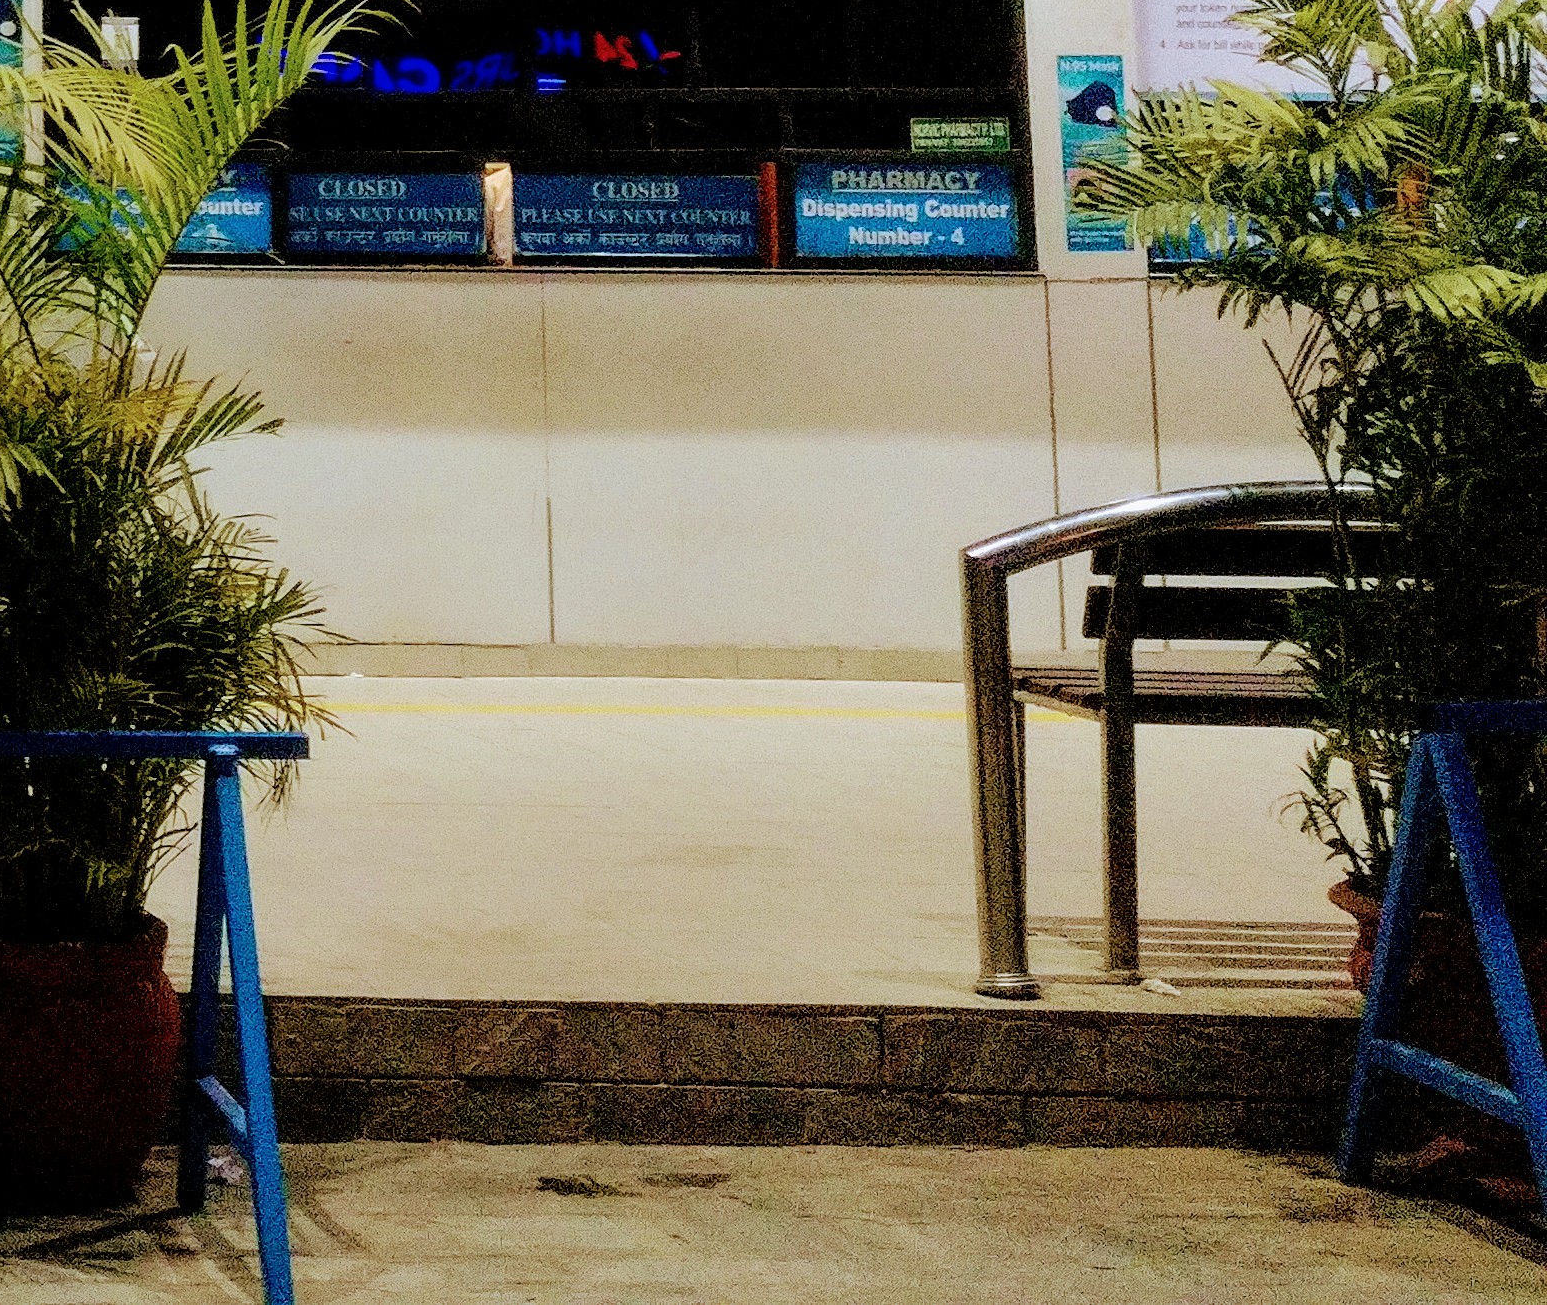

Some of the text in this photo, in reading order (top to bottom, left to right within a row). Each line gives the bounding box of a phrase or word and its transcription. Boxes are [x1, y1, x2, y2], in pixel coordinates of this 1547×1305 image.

[1176, 5, 1197, 15] your
[1178, 40, 1196, 49] Ask
[318, 180, 407, 197] CLOSED
[831, 170, 980, 190] PHARMACY
[593, 181, 679, 199] CLOSED
[198, 198, 264, 215] ounter
[350, 207, 393, 222] NEXT
[398, 207, 479, 222] COUNTER
[802, 198, 1010, 222] Dispensing Counter
[521, 208, 752, 224] PLEASE USE NEXT COUNTER
[849, 227, 932, 245] Number
[950, 227, 964, 245] 4
